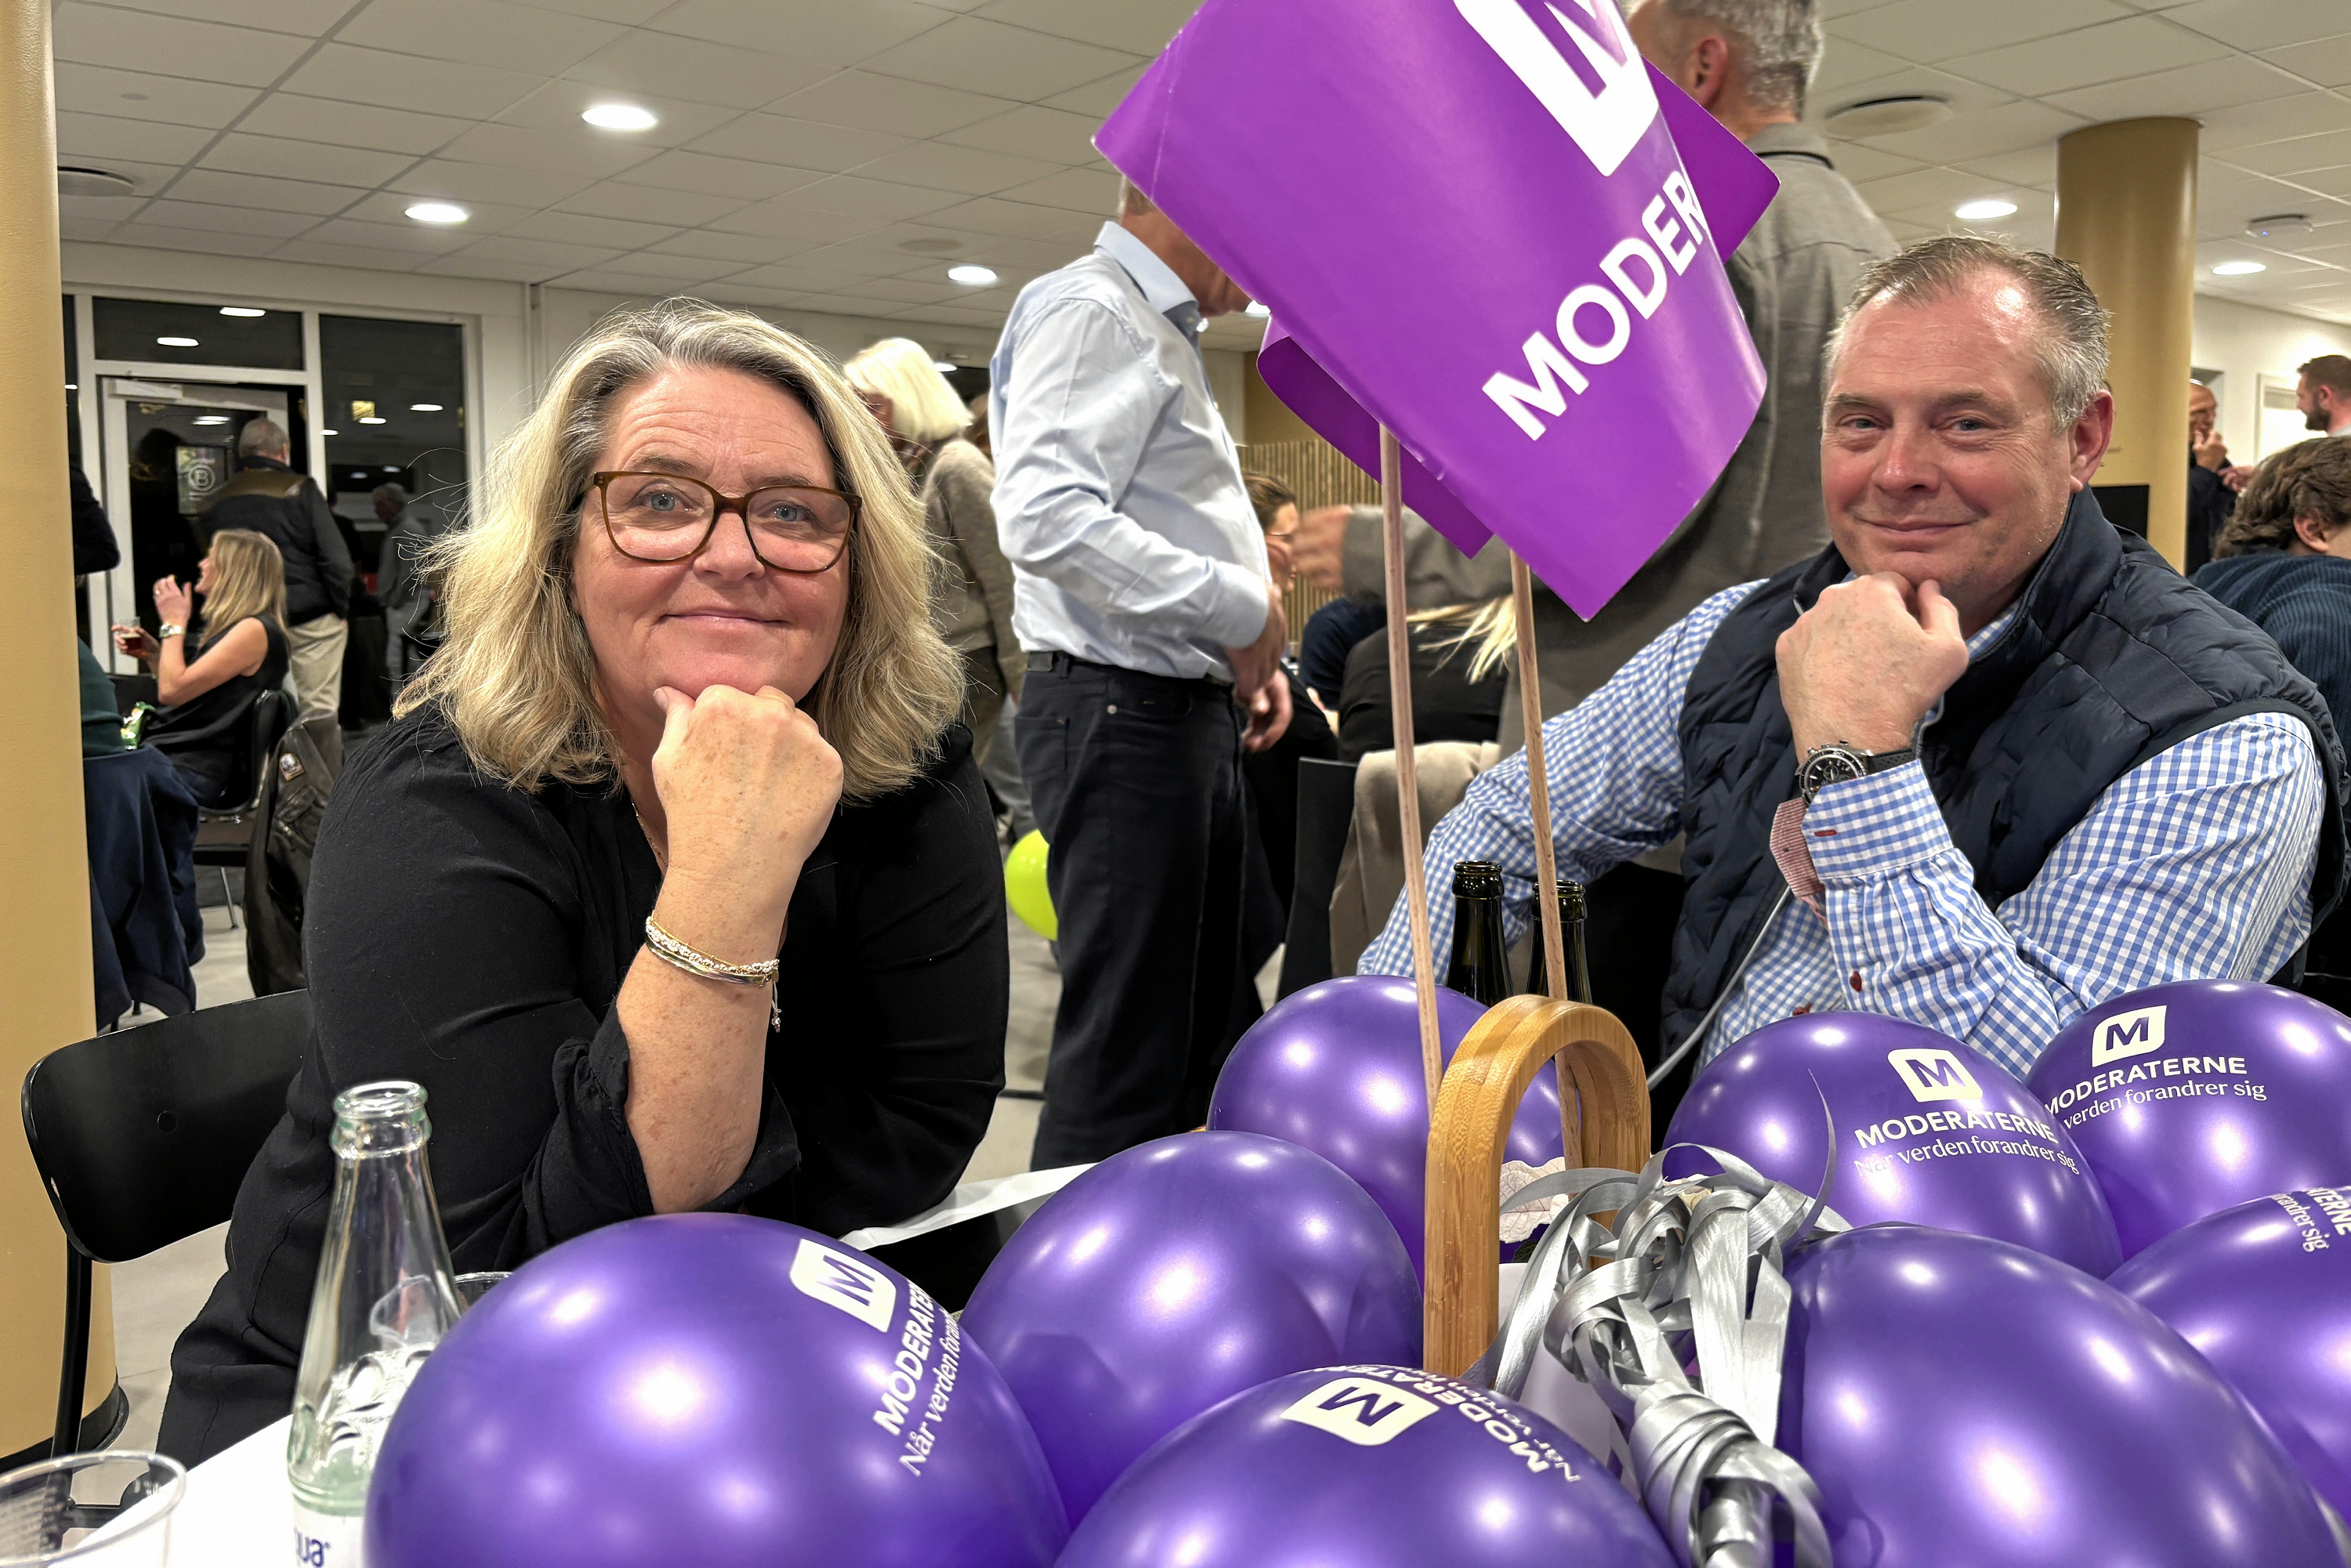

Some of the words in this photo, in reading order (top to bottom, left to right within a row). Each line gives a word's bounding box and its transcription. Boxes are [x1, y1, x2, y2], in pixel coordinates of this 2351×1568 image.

[2105, 1016, 2150, 1051] M
[1905, 1059, 1966, 1088] M
[2045, 1056, 2248, 1114] MODERATERNE
[2063, 1096, 2121, 1129] verden
[2125, 1081, 2228, 1105] forandrer
[2233, 1080, 2267, 1101] sig
[1853, 1110, 2059, 1150] MODERATERNE
[1896, 1139, 1971, 1164] verden
[1971, 1136, 2056, 1161] forandrer
[2056, 1150, 2080, 1175] sig
[2302, 1228, 2331, 1252] sig
[817, 1255, 876, 1307] M
[899, 1421, 936, 1477] Når
[926, 1353, 959, 1423] verden
[1317, 1386, 1405, 1427] M
[1447, 1382, 1532, 1436] verden
